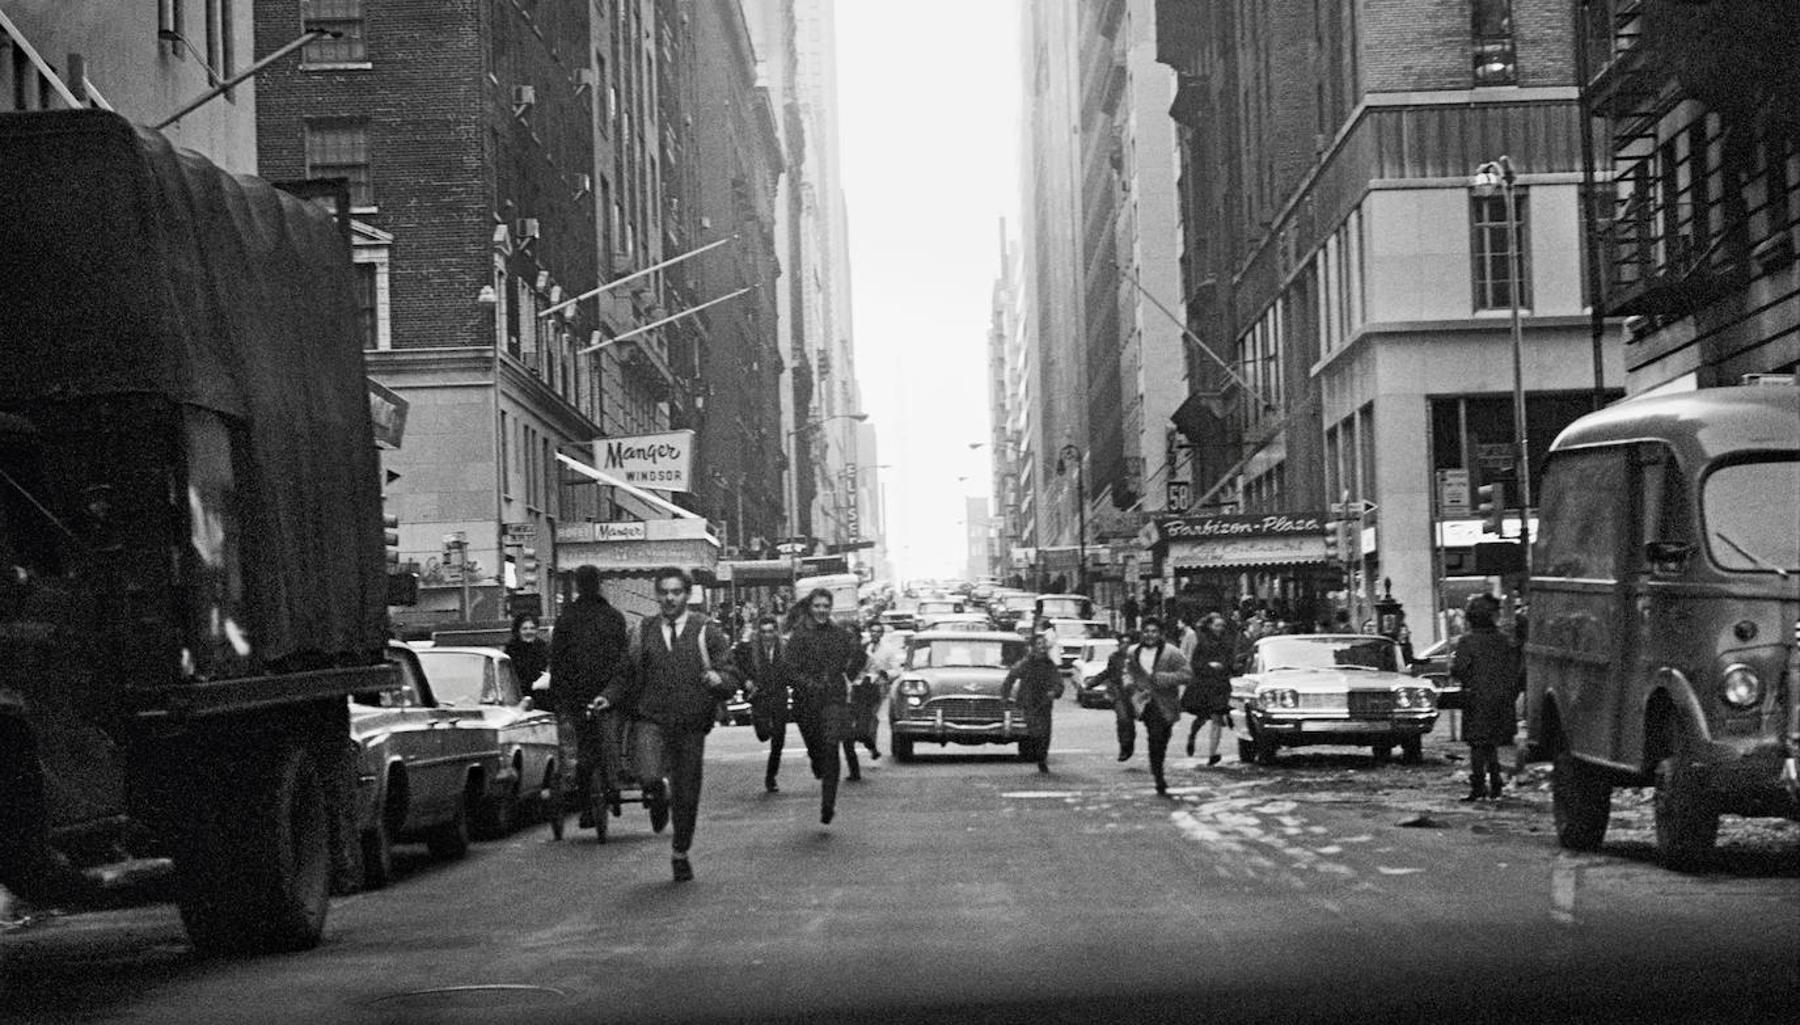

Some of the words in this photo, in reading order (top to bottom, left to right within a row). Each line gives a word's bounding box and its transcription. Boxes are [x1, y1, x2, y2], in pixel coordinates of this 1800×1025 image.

[604, 442, 681, 468] Manger
[625, 470, 682, 481] WINDSOR
[1169, 485, 1188, 511] 58
